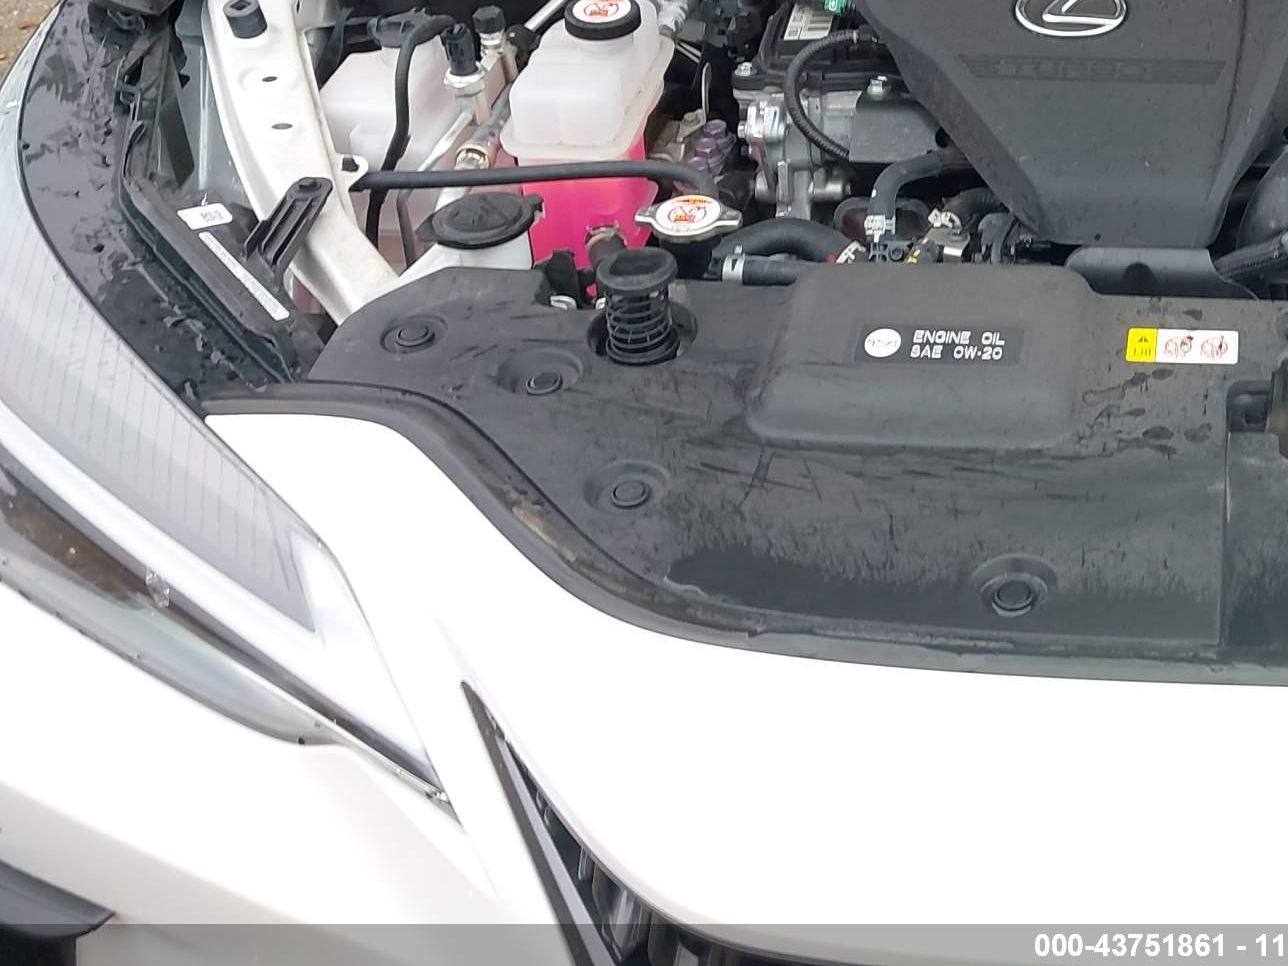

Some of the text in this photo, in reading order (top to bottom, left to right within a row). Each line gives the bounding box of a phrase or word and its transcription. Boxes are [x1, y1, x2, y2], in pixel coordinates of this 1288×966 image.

[912, 329, 971, 345] ENGINE
[981, 331, 1005, 346] OIL
[910, 344, 1003, 360] SAE 0W-20
